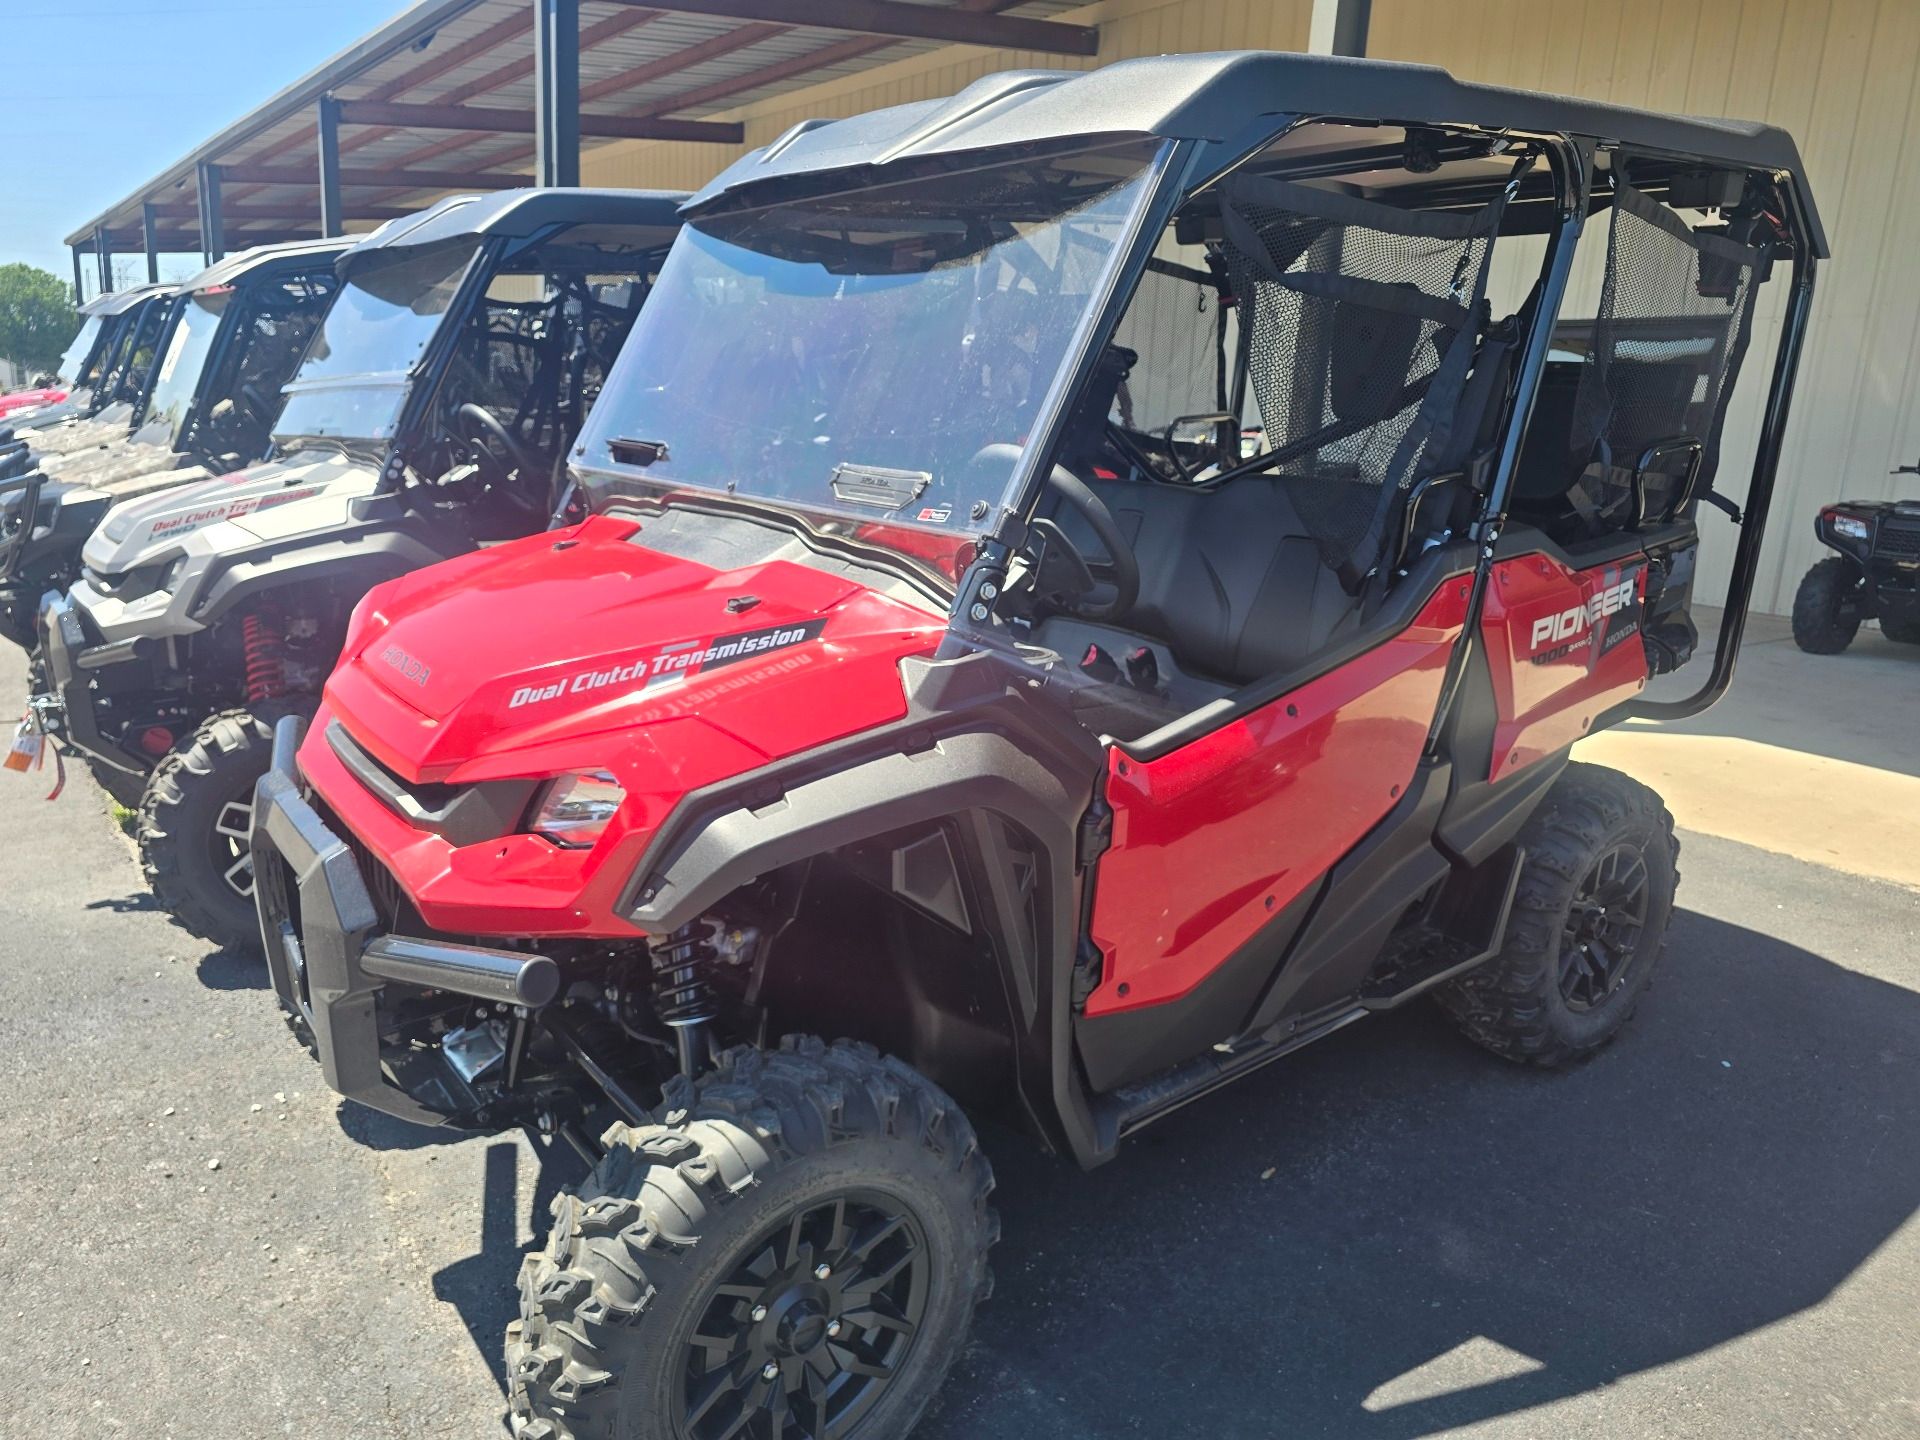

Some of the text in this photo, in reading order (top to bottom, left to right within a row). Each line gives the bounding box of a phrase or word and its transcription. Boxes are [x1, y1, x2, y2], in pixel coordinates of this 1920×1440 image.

[152, 516, 183, 532] Dual
[185, 503, 226, 524] Clutch
[1530, 578, 1634, 650] PIONEER
[1605, 621, 1638, 649] HONDA
[384, 647, 430, 686] HONDA
[508, 627, 806, 709] Dual Clutch Transmission
